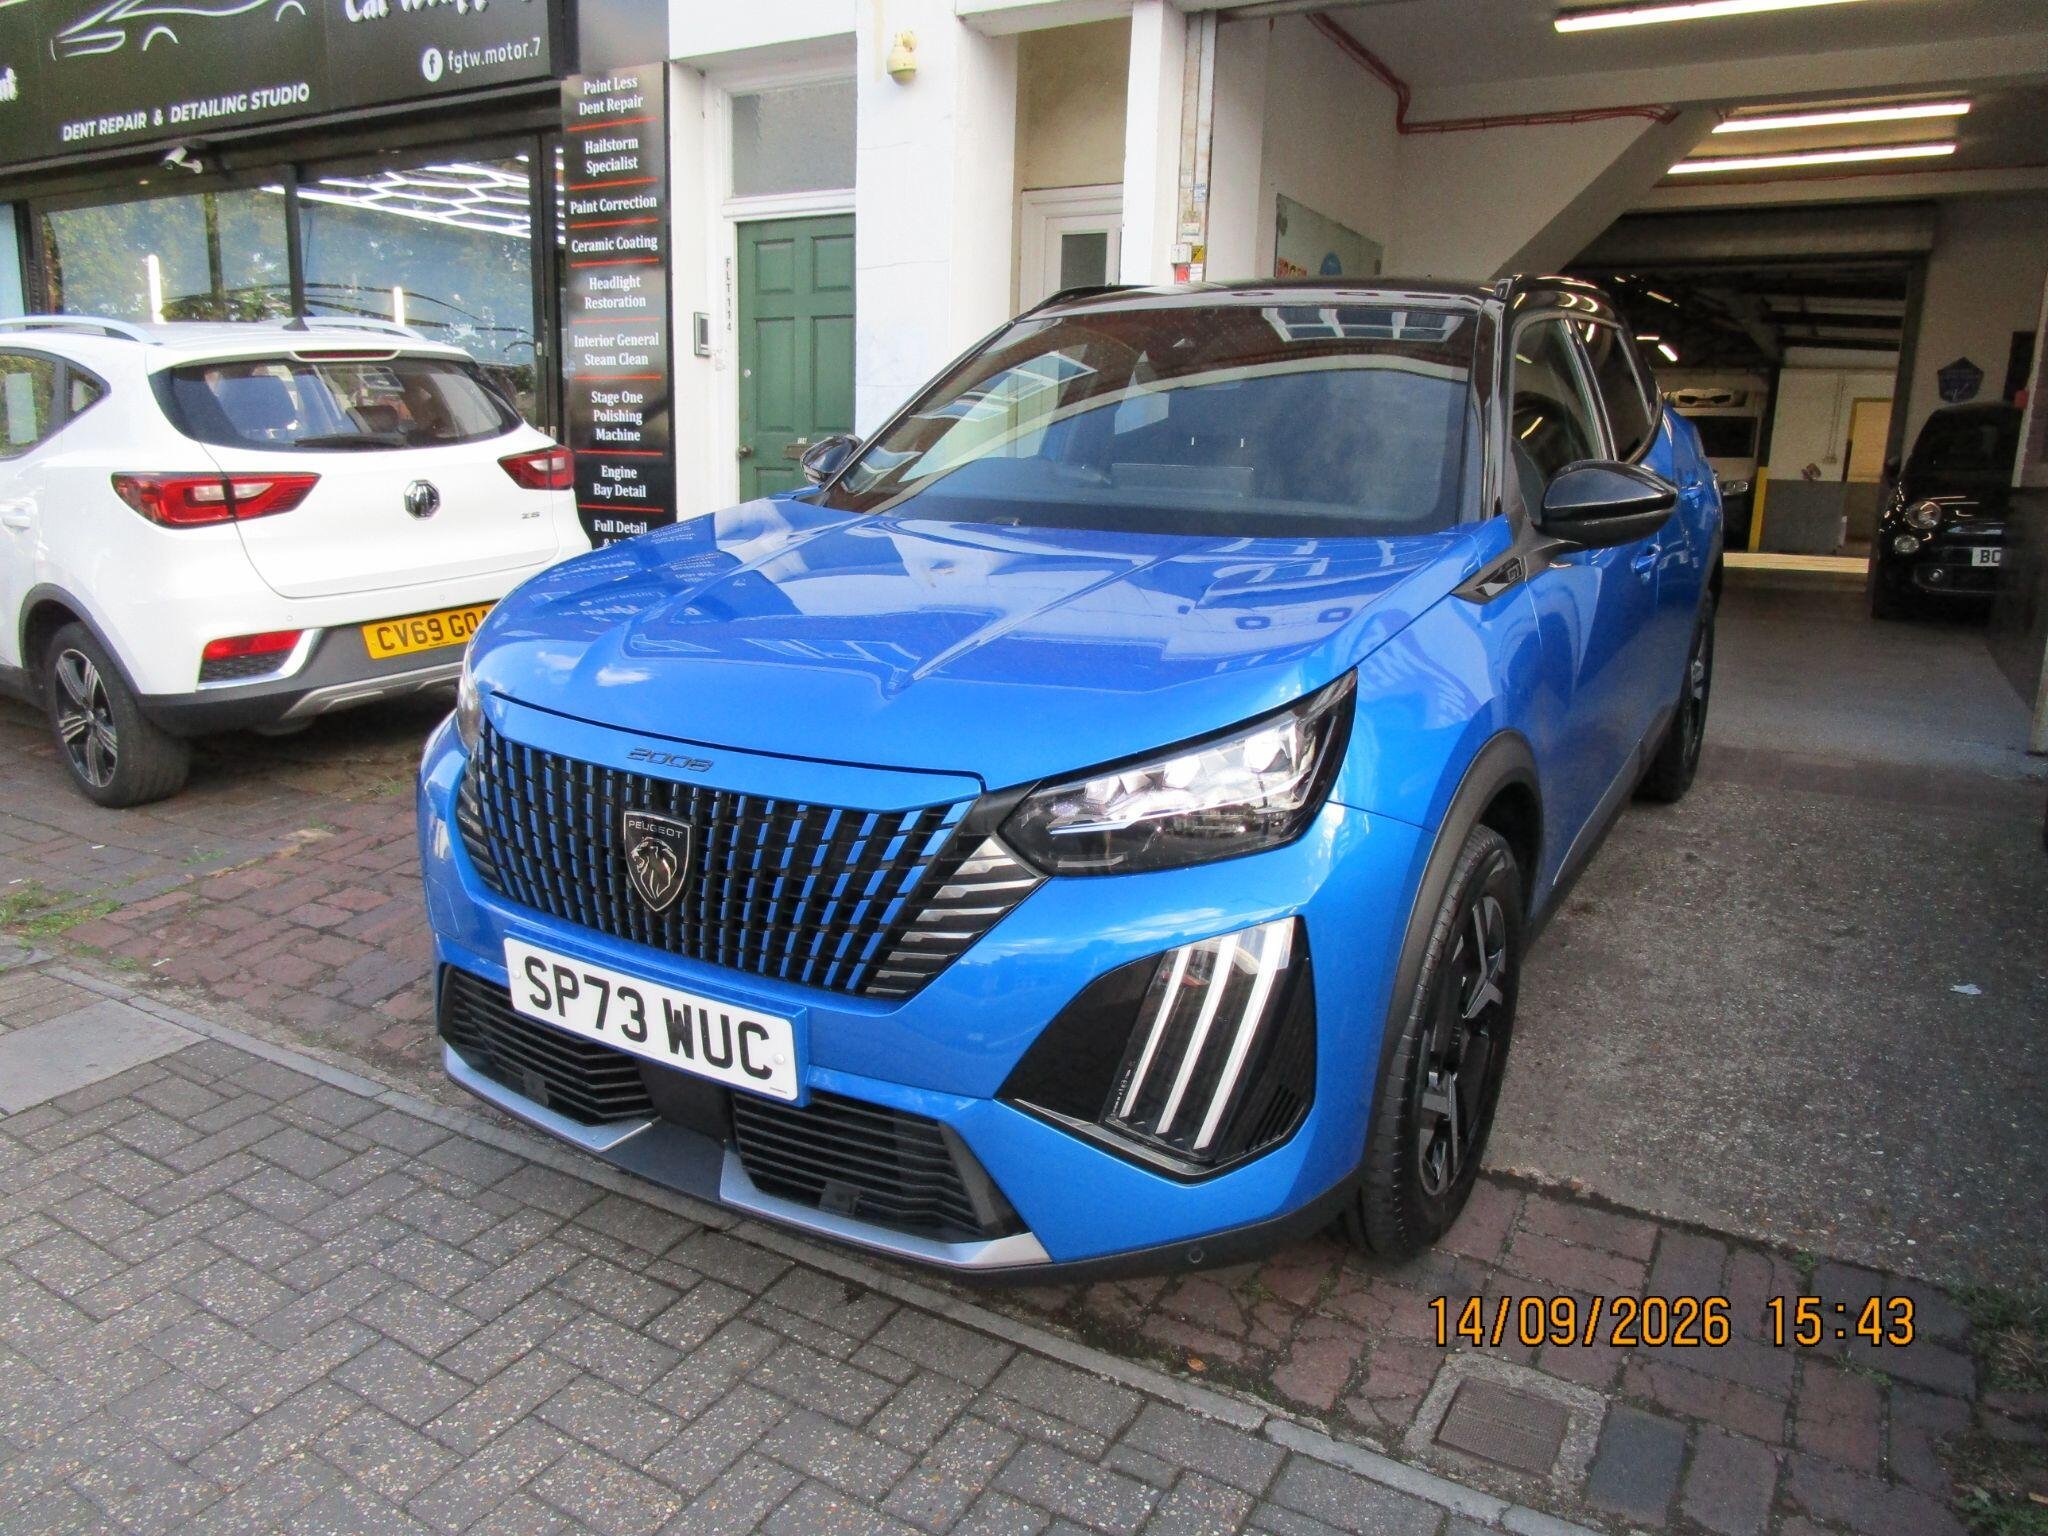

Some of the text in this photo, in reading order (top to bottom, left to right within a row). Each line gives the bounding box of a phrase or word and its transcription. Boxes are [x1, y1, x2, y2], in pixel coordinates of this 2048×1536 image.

[447, 37, 541, 74] fgtw.motor.7
[583, 76, 639, 96] Paint Less
[63, 82, 310, 142] DENT REPAIR & DETAILING STUDIO
[579, 95, 643, 116] Dent Repair
[585, 137, 639, 155] Hailstorm
[586, 156, 639, 177] Specialist
[570, 195, 658, 215] Paint Correction
[571, 234, 658, 254] Ceramic Coating
[589, 274, 641, 293] Headlight
[584, 294, 647, 311] Restoration
[574, 332, 659, 348] Interior General
[584, 352, 649, 367] Steam Clean
[591, 390, 644, 405] Stage One
[593, 409, 643, 426] Polishing
[595, 428, 641, 442] Machine
[601, 465, 638, 482] Engine
[593, 483, 647, 499] Bay Detail
[593, 519, 614, 533] Full
[616, 520, 647, 535] Detail
[376, 617, 444, 651] CV69
[627, 747, 714, 773] 2008
[628, 819, 684, 839] PEUGEOT
[524, 955, 773, 1081] SP73 WUC
